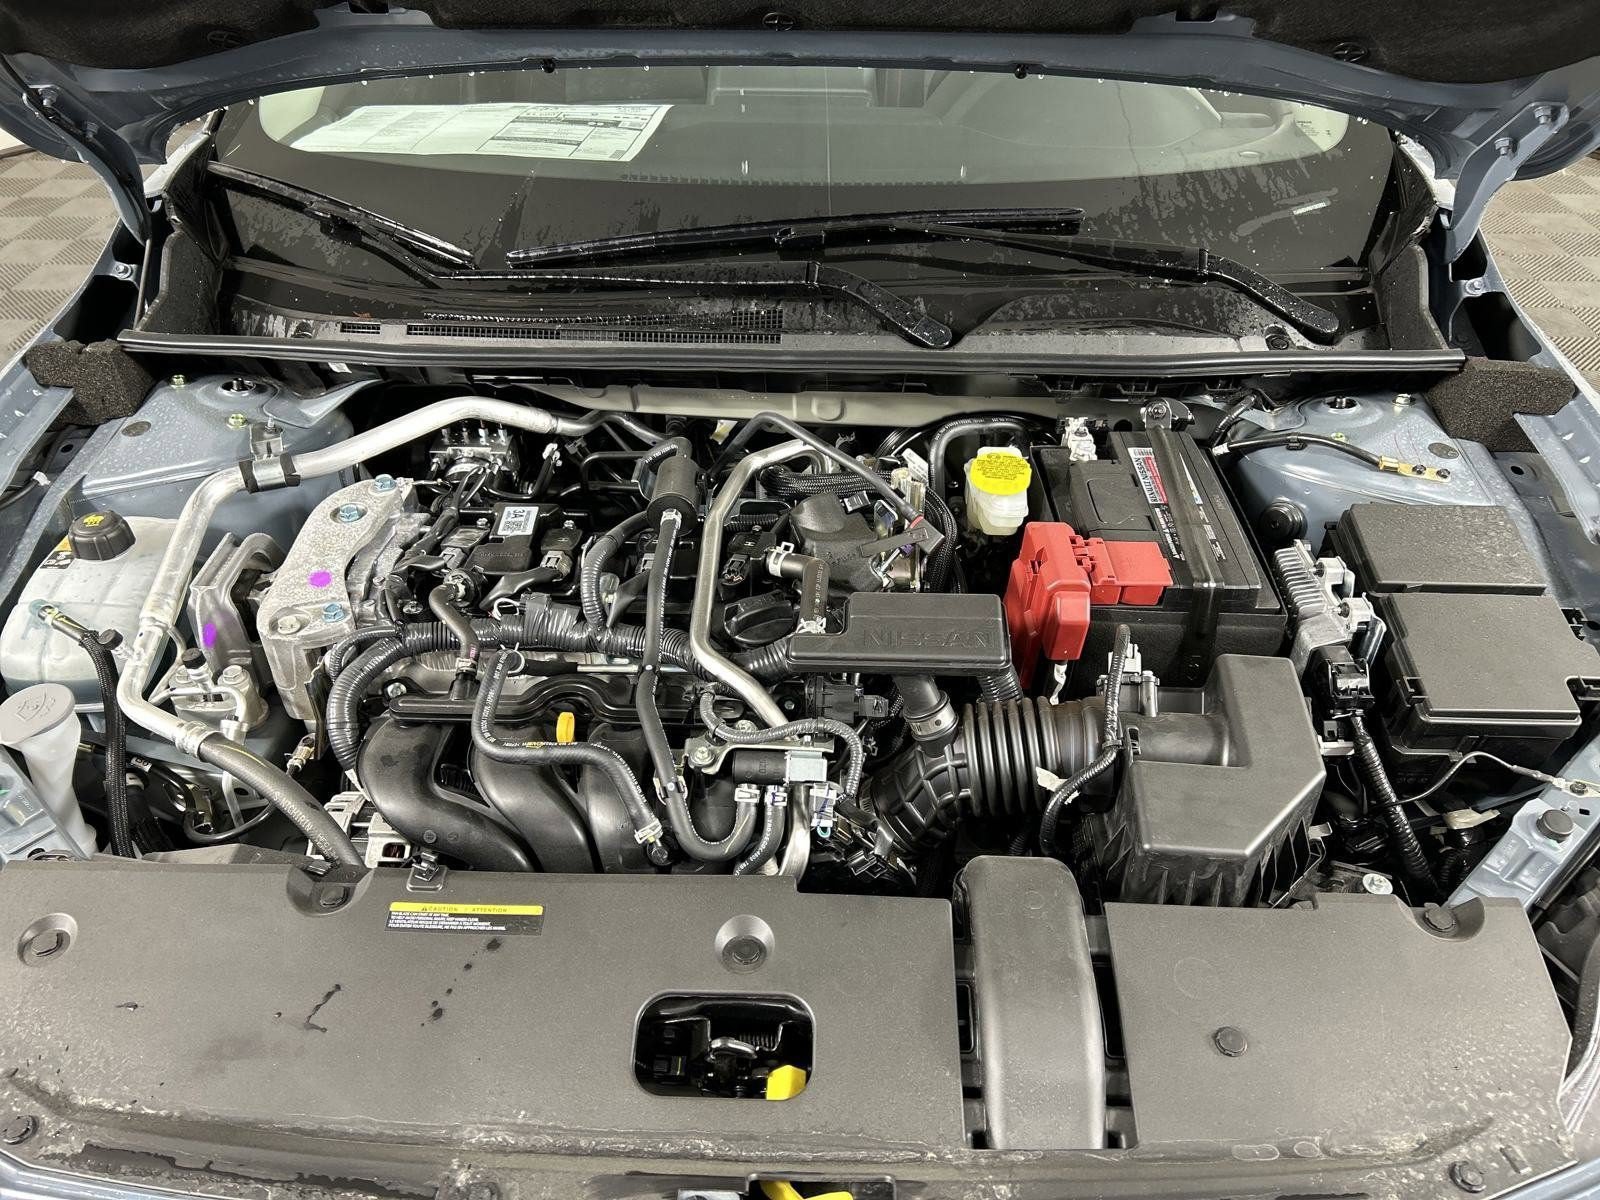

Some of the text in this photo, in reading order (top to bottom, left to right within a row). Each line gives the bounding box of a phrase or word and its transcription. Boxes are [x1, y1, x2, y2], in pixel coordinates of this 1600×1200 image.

[1134, 457, 1149, 480] NISSAN
[511, 508, 526, 519] 3A
[863, 631, 997, 649] NISSAN
